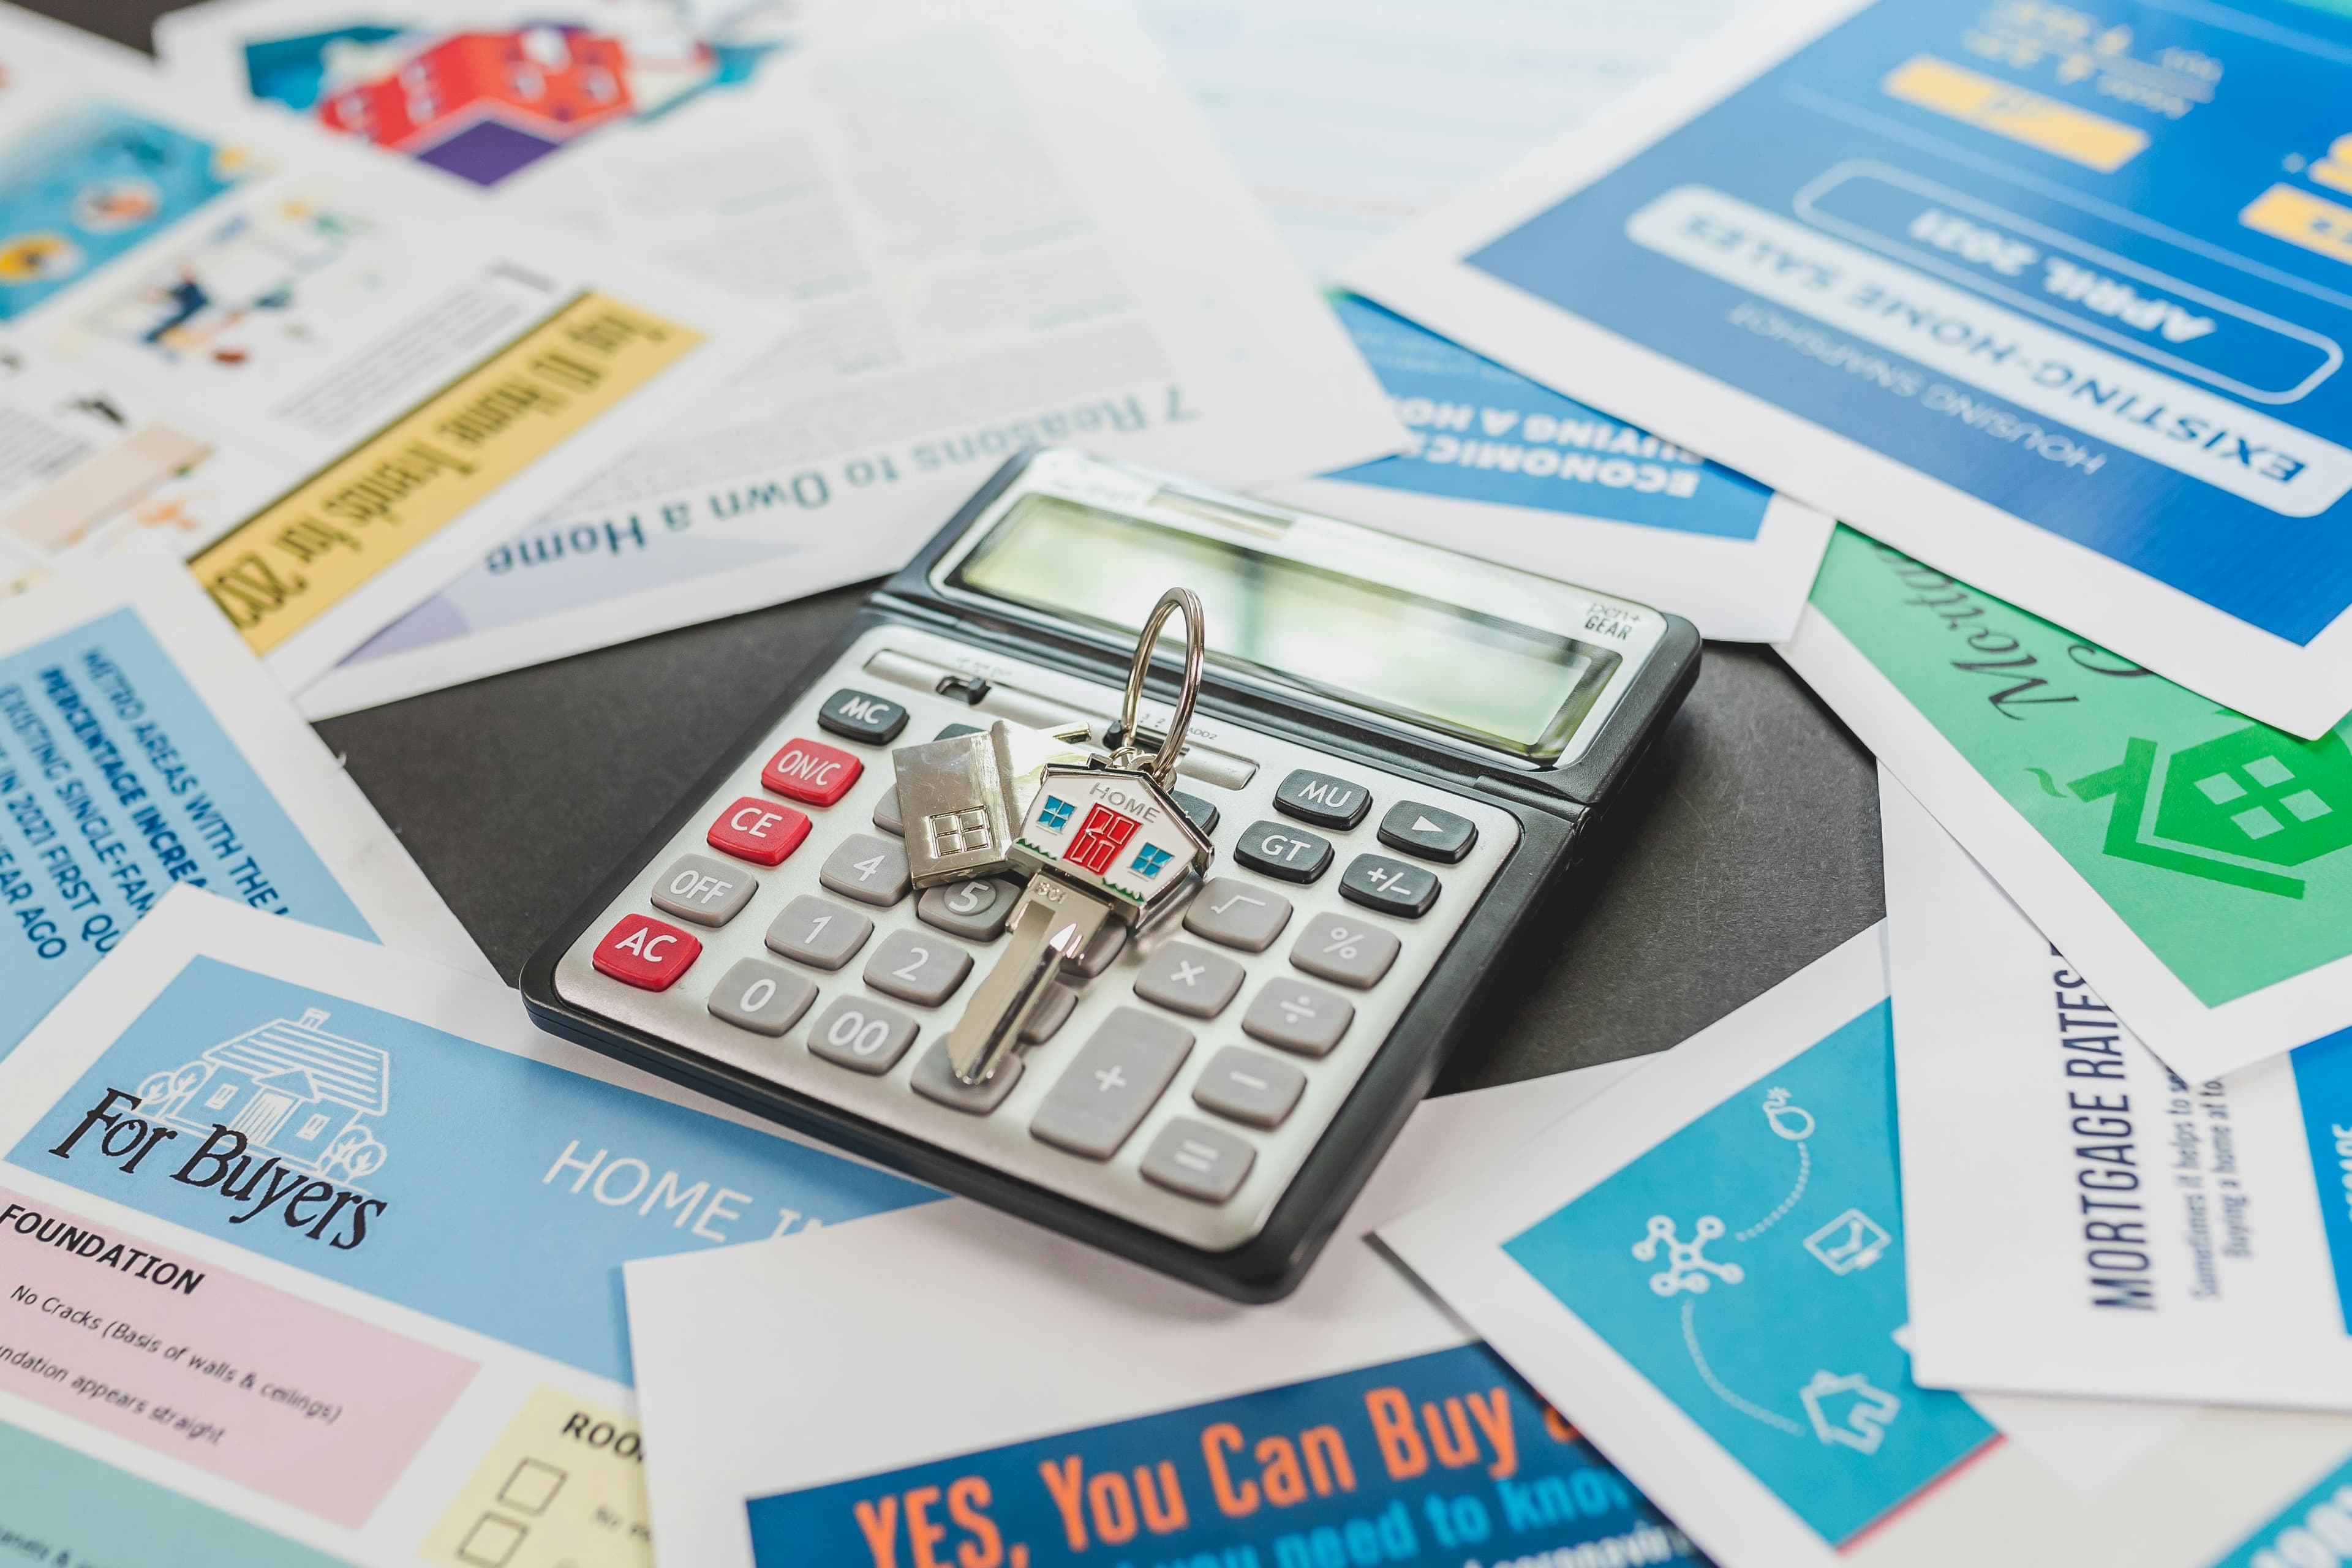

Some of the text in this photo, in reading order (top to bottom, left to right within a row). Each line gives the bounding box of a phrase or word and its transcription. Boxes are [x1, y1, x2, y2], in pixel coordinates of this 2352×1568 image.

[2043, 256, 2217, 344] APRIL
[1165, 384, 1200, 423] 7
[1856, 282, 2305, 485] EXISTING-HOME
[910, 394, 1149, 472] Reasons
[1392, 396, 1475, 432] HO
[1480, 409, 1520, 437] A
[1921, 383, 2106, 476] HOUSING
[844, 453, 900, 488] to
[708, 470, 832, 521] Own
[662, 503, 692, 532] a
[485, 513, 647, 576] Home
[1585, 615, 1632, 641] GEAR
[838, 696, 889, 725] MC
[39, 668, 148, 806] PERCENTAGE
[776, 749, 842, 787] ON/C
[132, 722, 198, 796] AREAS
[185, 792, 244, 859] WITH
[229, 856, 279, 909] THE
[1090, 782, 1161, 824] HOME
[1297, 779, 1353, 810] MU
[730, 807, 783, 839] CE
[853, 854, 887, 883] 4
[1261, 834, 1311, 862] GT
[38, 845, 101, 911] FIRST
[669, 869, 733, 905] OFF
[949, 882, 989, 913] 5
[0, 843, 67, 960] EAR AGO
[614, 926, 677, 963] AC
[803, 915, 833, 944] 1
[892, 947, 929, 982] 2
[739, 978, 777, 1012] 0
[827, 1011, 890, 1057] 00
[2164, 1098, 2192, 1115] to
[2197, 1077, 2225, 1098] to
[2200, 1102, 2228, 1120] at
[48, 1087, 388, 1250] For Buyers
[2207, 1124, 2237, 1174] home
[541, 1140, 753, 1242] HOME
[2068, 1091, 2156, 1313] MORTGAGE
[0, 1204, 206, 1296] FOUNDATION
[10, 1284, 344, 1426] No Cracks (Basis of walls & ceilings)
[0, 1345, 227, 1444] ndation appears straight
[561, 1412, 643, 1463] ROO
[1038, 1455, 1190, 1553] You
[1199, 1421, 1358, 1520] Can
[1363, 1385, 1519, 1481] Buy
[1423, 1490, 1492, 1551] to
